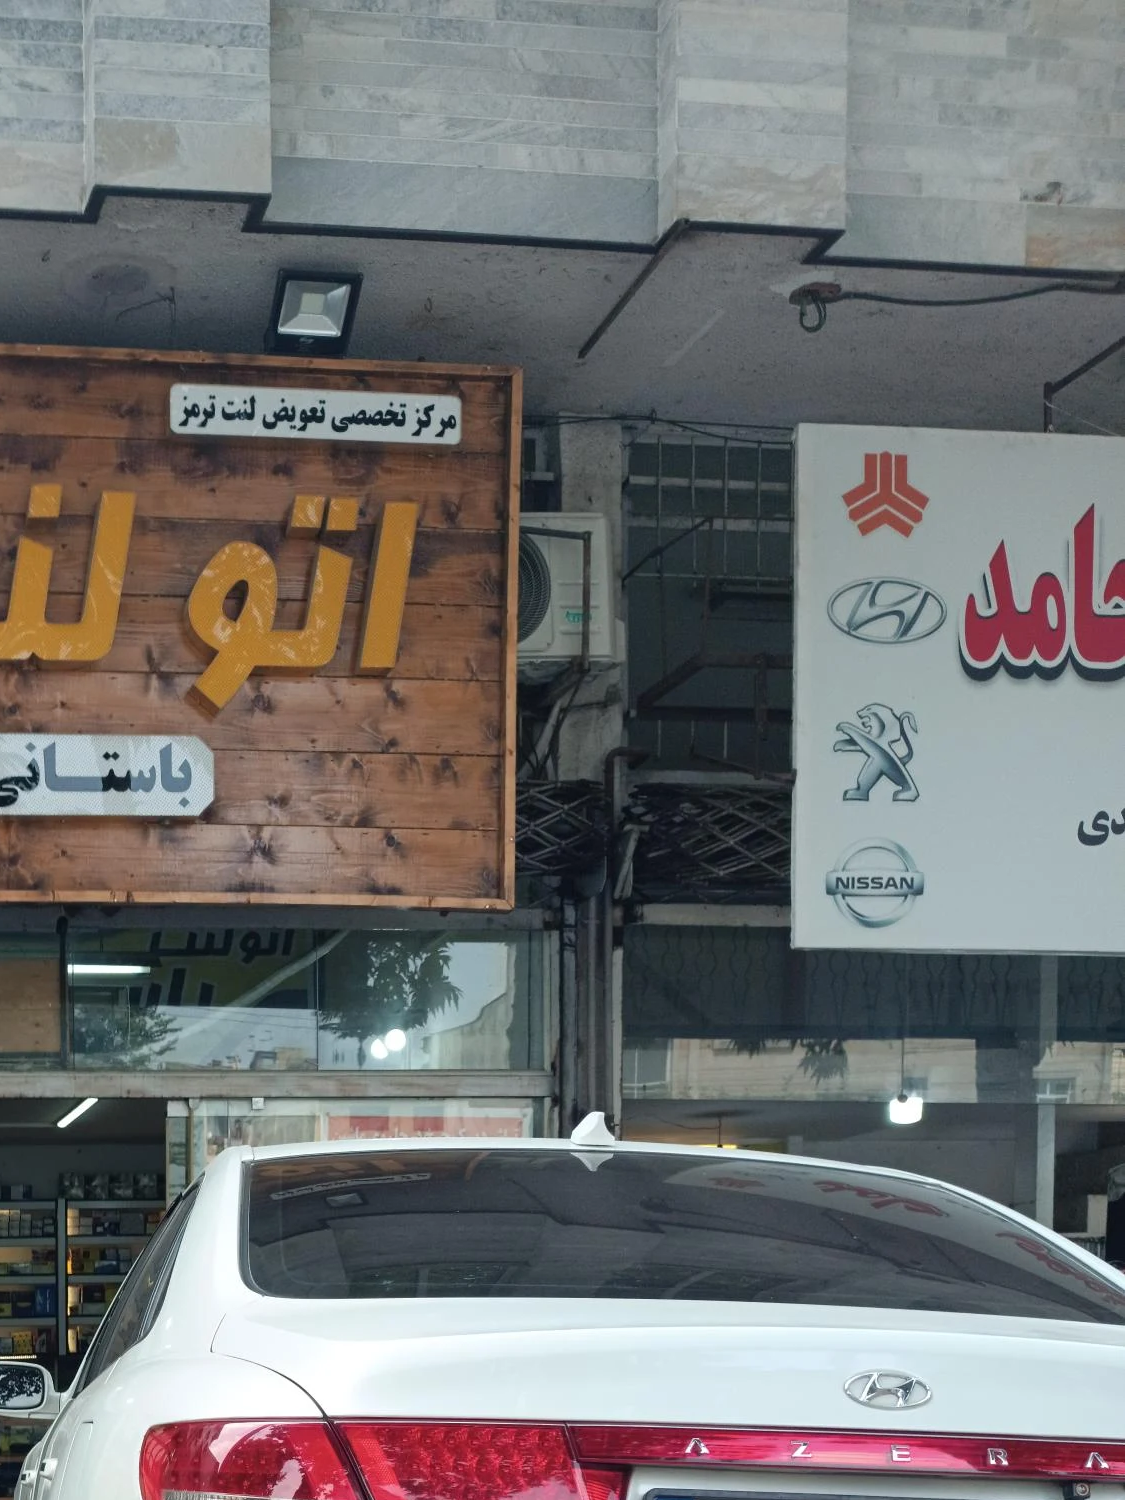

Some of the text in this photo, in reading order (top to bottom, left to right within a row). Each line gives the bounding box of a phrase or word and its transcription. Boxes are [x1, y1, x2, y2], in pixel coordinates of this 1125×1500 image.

[178, 395, 458, 438] مرکز تخصصی تعویض لنت ترمز
[184, 495, 417, 716] اتو
[834, 875, 916, 891] NISSAN
